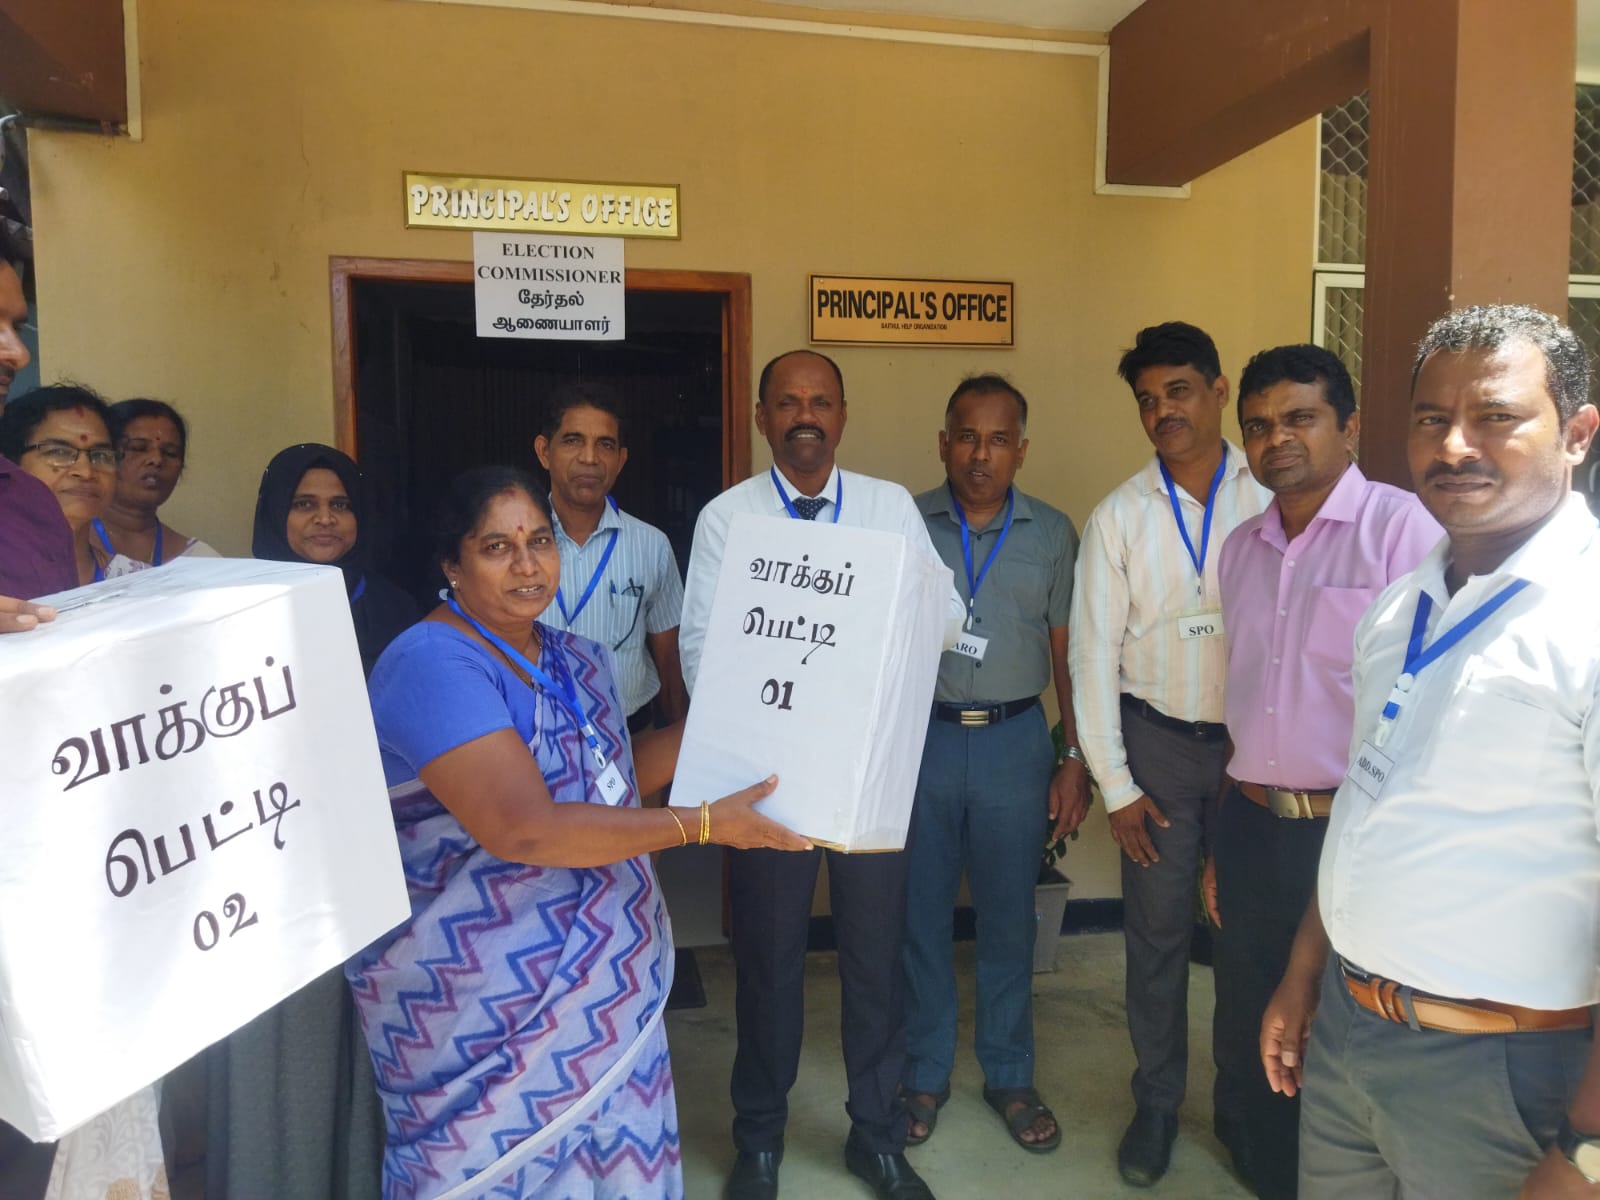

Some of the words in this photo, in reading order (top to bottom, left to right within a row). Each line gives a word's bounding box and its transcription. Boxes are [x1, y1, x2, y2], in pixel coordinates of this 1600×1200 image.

[410, 184, 571, 222] PRINCIPAL'S
[581, 194, 673, 227] OFFICE
[502, 243, 595, 260] ELECTION
[477, 265, 622, 284] COMMISSIONER
[518, 288, 584, 309] தேர்தல்
[817, 289, 938, 320] PRINCIPAL'S
[942, 293, 1007, 322] OFFICE
[492, 316, 610, 335] ஆணையாளர்
[750, 554, 855, 597] வாக்குப்
[742, 606, 836, 665] பெட்டி
[1188, 624, 1214, 636] SPO
[761, 678, 794, 710] 01
[51, 656, 297, 791] வாக்குப்
[105, 782, 301, 898] பெட்டி
[193, 892, 259, 951] 02
